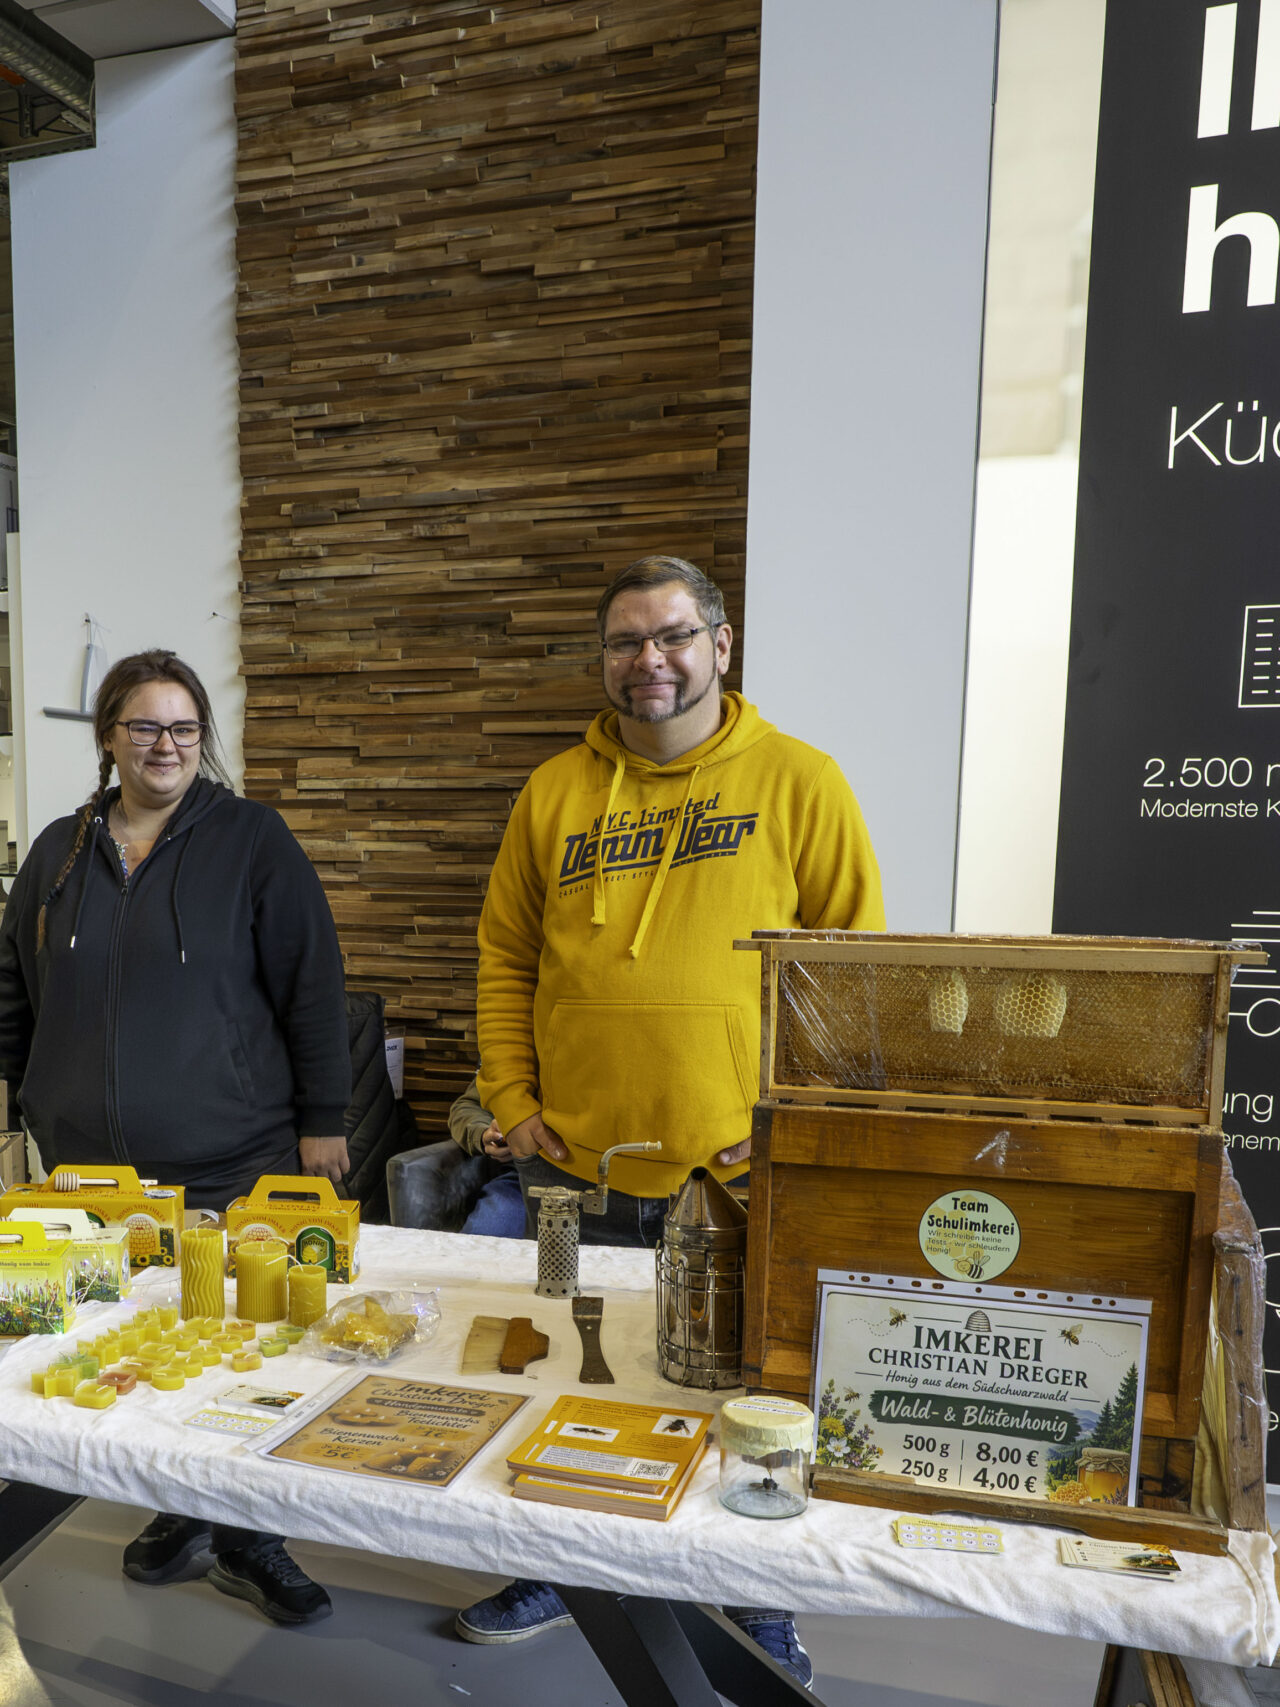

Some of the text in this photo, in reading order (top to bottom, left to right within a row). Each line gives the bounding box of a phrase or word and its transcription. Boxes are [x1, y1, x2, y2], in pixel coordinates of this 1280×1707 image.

[1168, 400, 1280, 469] Kü
[1143, 757, 1252, 788] 2.500
[1140, 798, 1258, 818] Modernste
[952, 1197, 989, 1213] Team
[927, 1215, 1015, 1235] Schulimkerei
[928, 1237, 947, 1245] Tests
[968, 1243, 1010, 1252] schleudern
[944, 1231, 980, 1241] schreiben
[982, 1235, 1002, 1243] keine
[926, 1245, 951, 1254] Honig!
[913, 1325, 1044, 1362] IMKEREI
[869, 1347, 1089, 1388] CHRISTIAN DREGER
[395, 1383, 493, 1402] Imkerei
[885, 1369, 1069, 1402] Honig aus dem Südschwarzwald
[371, 1388, 499, 1409] Christian Dreger
[395, 1410, 481, 1424] Bienenwachs
[407, 1417, 472, 1429] Teelichter
[881, 1395, 1068, 1441] Wald- & Blütenhonig
[320, 1427, 406, 1443] Bienenwachs
[332, 1434, 384, 1447] Kerzen
[902, 1434, 1039, 1467] 500 g 8,00 €
[901, 1458, 1037, 1493] 250 g 4,00 €
